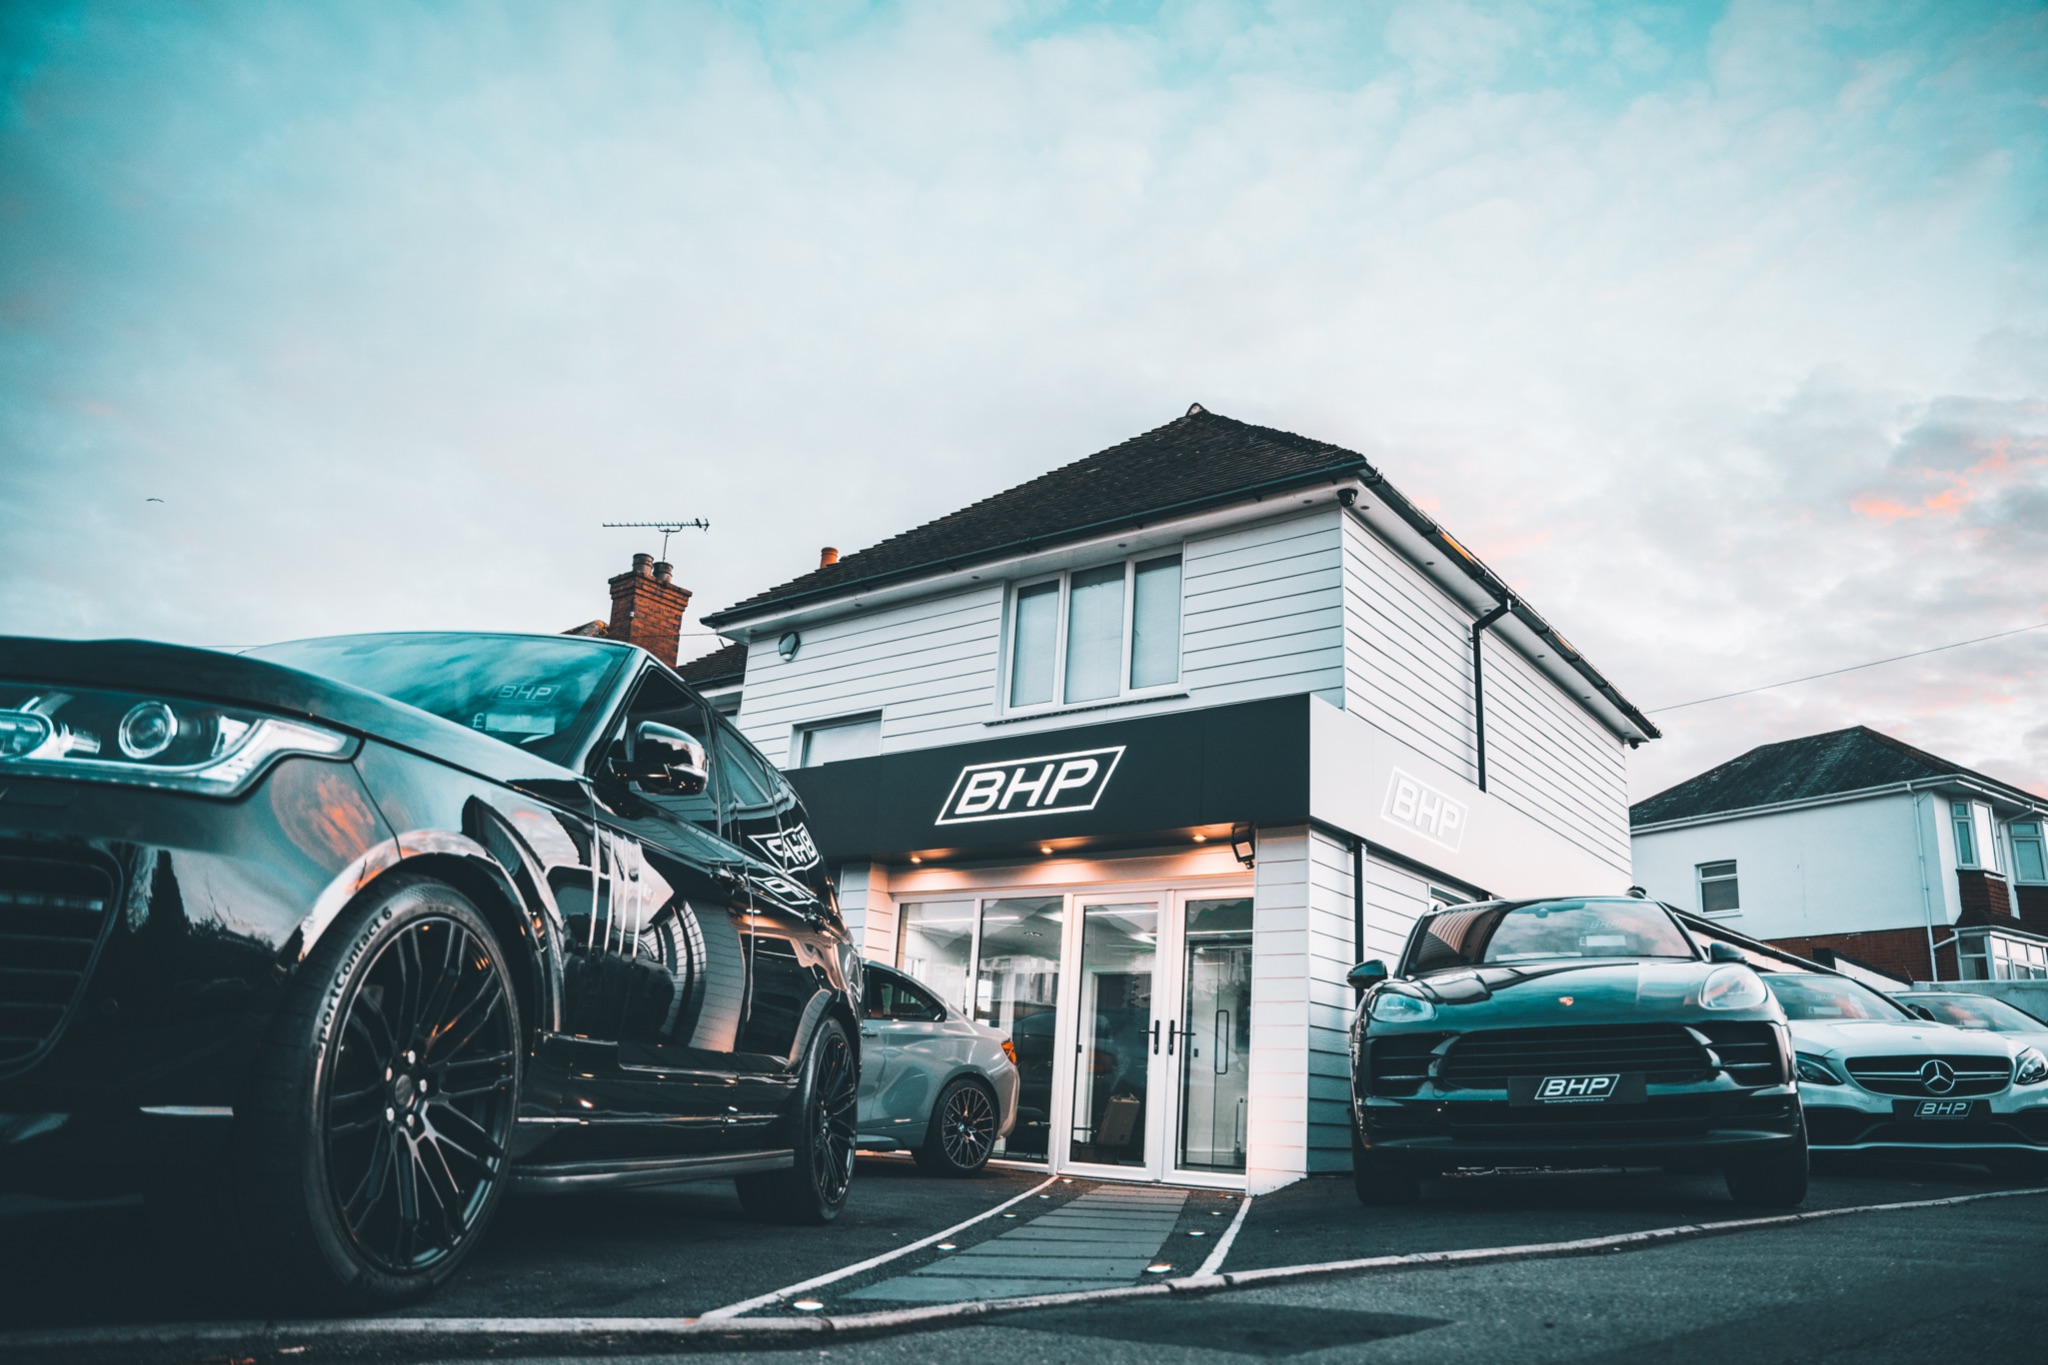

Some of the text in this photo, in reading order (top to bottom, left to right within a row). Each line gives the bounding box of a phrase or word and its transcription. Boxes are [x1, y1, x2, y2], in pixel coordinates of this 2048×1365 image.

[497, 685, 552, 700] BHP
[954, 758, 1099, 815] BHP
[1390, 777, 1461, 838] BHP
[311, 906, 393, 1059] SportContact 6
[1543, 1077, 1610, 1096] BHP
[1921, 1102, 1967, 1115] BHP
